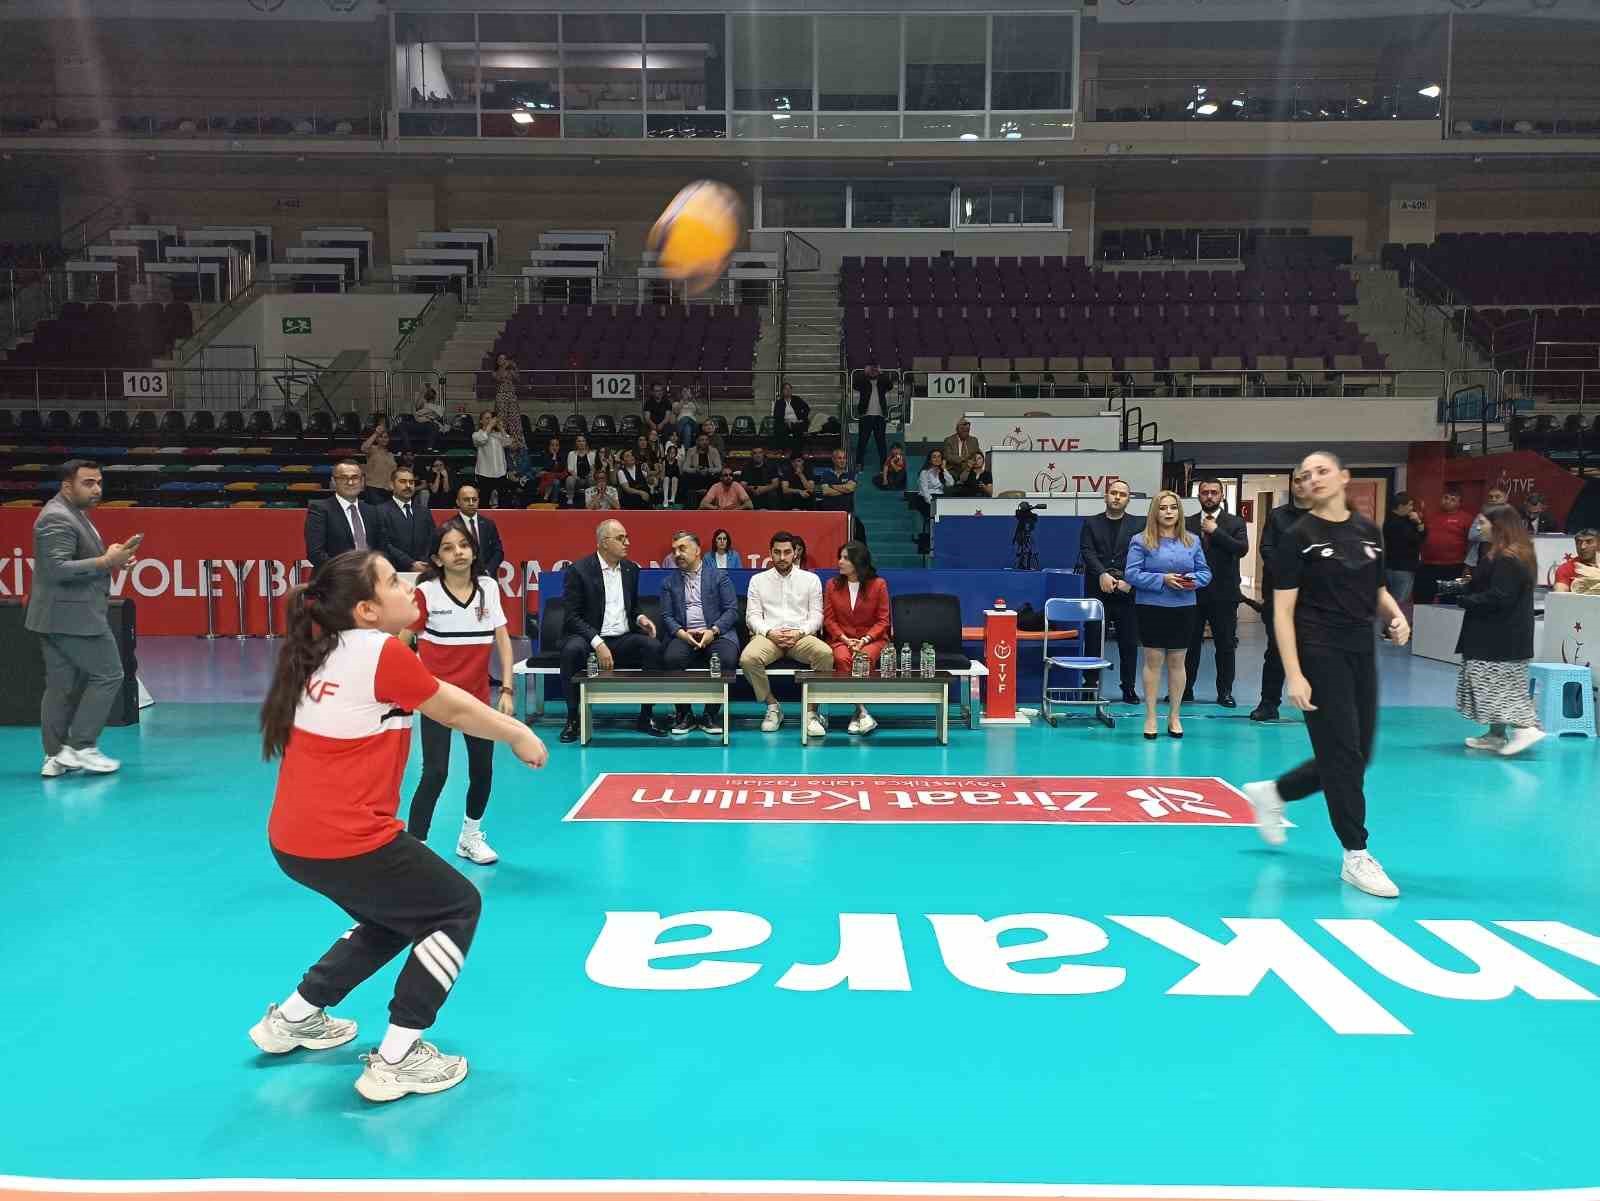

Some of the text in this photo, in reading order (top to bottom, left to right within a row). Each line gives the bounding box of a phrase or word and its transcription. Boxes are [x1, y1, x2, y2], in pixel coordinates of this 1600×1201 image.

[128, 375, 162, 392] 103
[596, 377, 631, 394] 102
[933, 377, 965, 394] 101
[1513, 478, 1534, 492] TVF
[998, 663, 1008, 694] TVF
[807, 780, 865, 788] daha
[885, 791, 1112, 813] Ziraat
